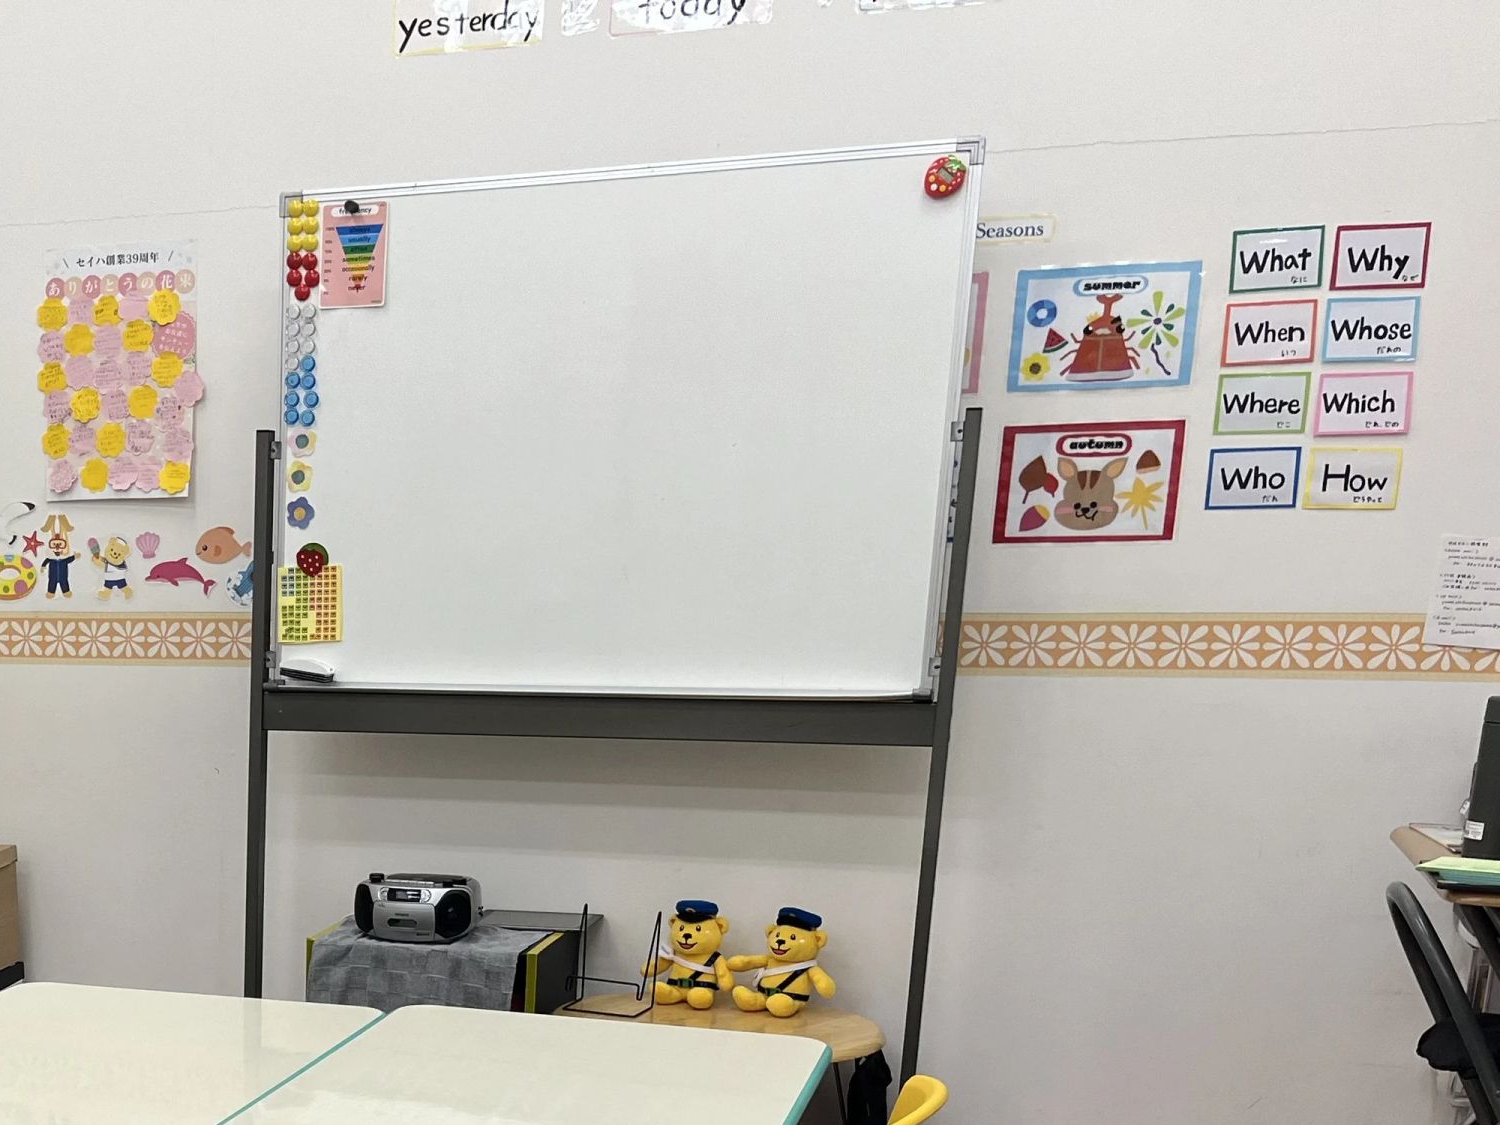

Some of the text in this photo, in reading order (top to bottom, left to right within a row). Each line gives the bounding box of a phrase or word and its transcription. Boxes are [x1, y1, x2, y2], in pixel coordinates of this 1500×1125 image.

[399, 0, 541, 53] yesterday
[976, 222, 1044, 239] Seasons
[76, 252, 160, 268] セイハ創業39周年
[1240, 247, 1312, 274] What
[1348, 244, 1410, 280] Why
[1083, 280, 1141, 291] summer
[1291, 276, 1308, 284] なに
[1234, 321, 1305, 346] When
[1330, 316, 1412, 342] Whose
[1223, 391, 1301, 414] Where
[1322, 390, 1396, 414] Which
[1069, 439, 1124, 450] autumn
[1220, 465, 1286, 491] Who
[1322, 463, 1388, 493] How
